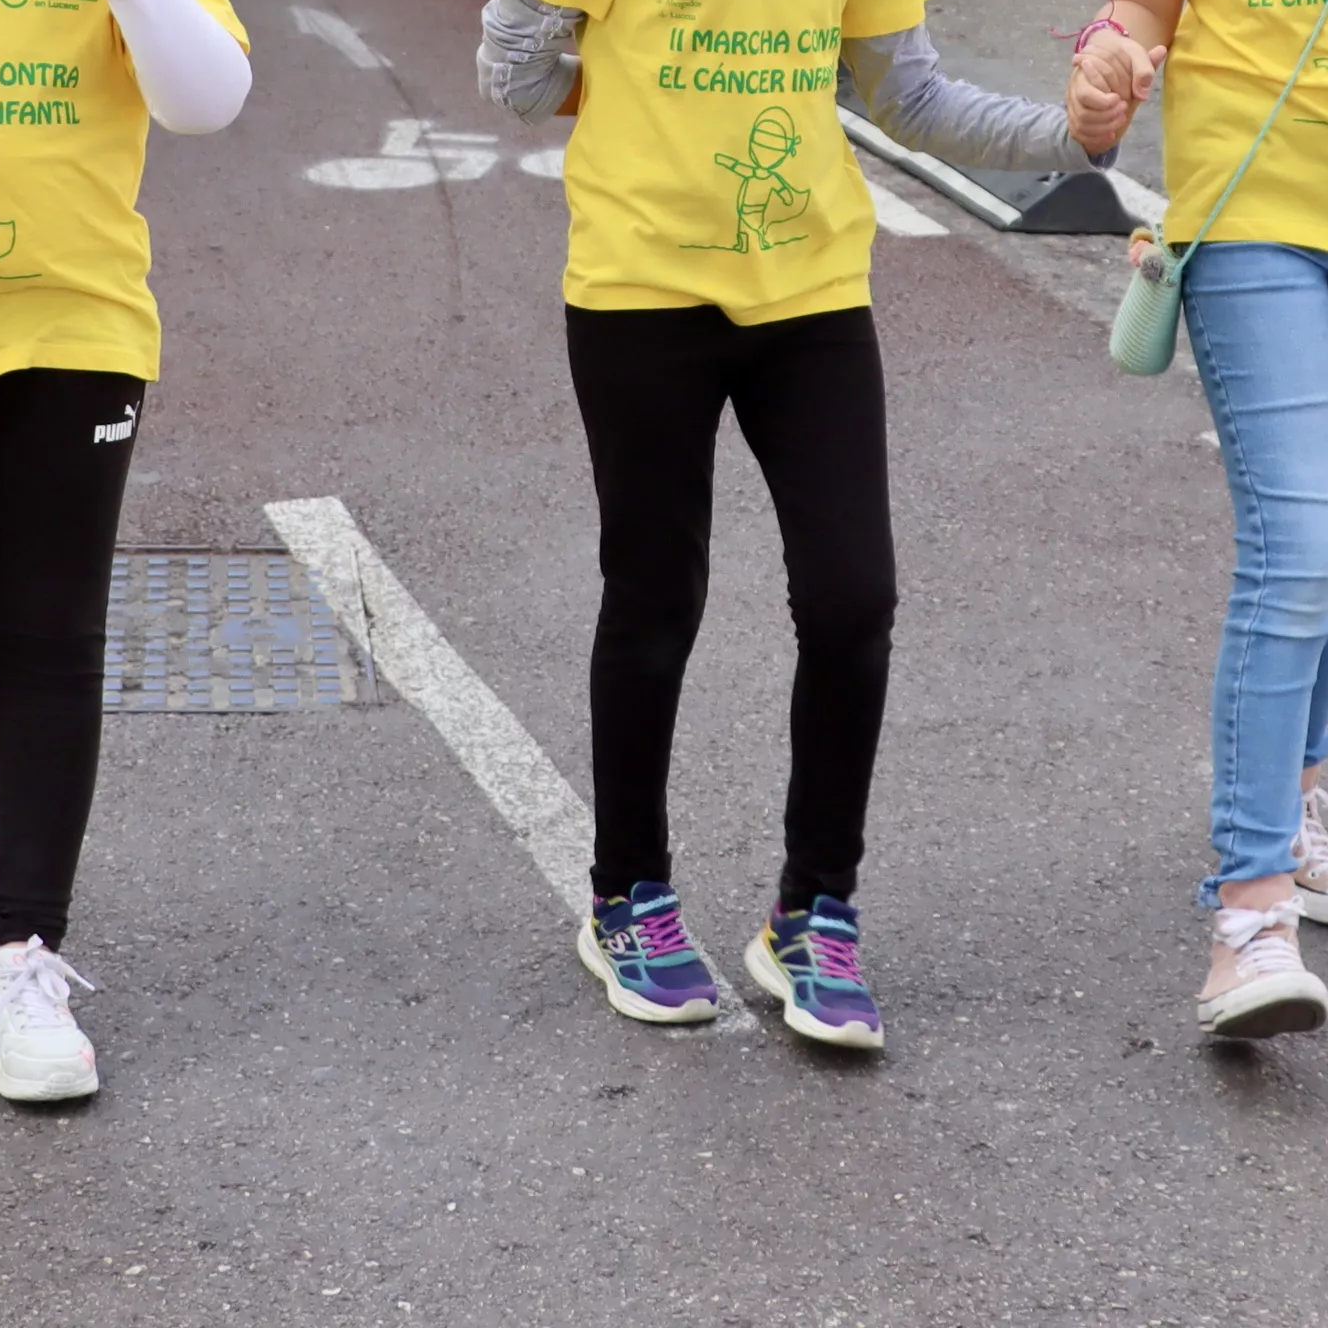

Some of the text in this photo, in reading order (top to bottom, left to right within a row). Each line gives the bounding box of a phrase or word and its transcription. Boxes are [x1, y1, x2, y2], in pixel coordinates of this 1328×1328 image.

[670, 27, 685, 52] II
[692, 29, 791, 56] MARCHA
[659, 65, 686, 89] EL
[693, 62, 785, 94] CÁNCER
